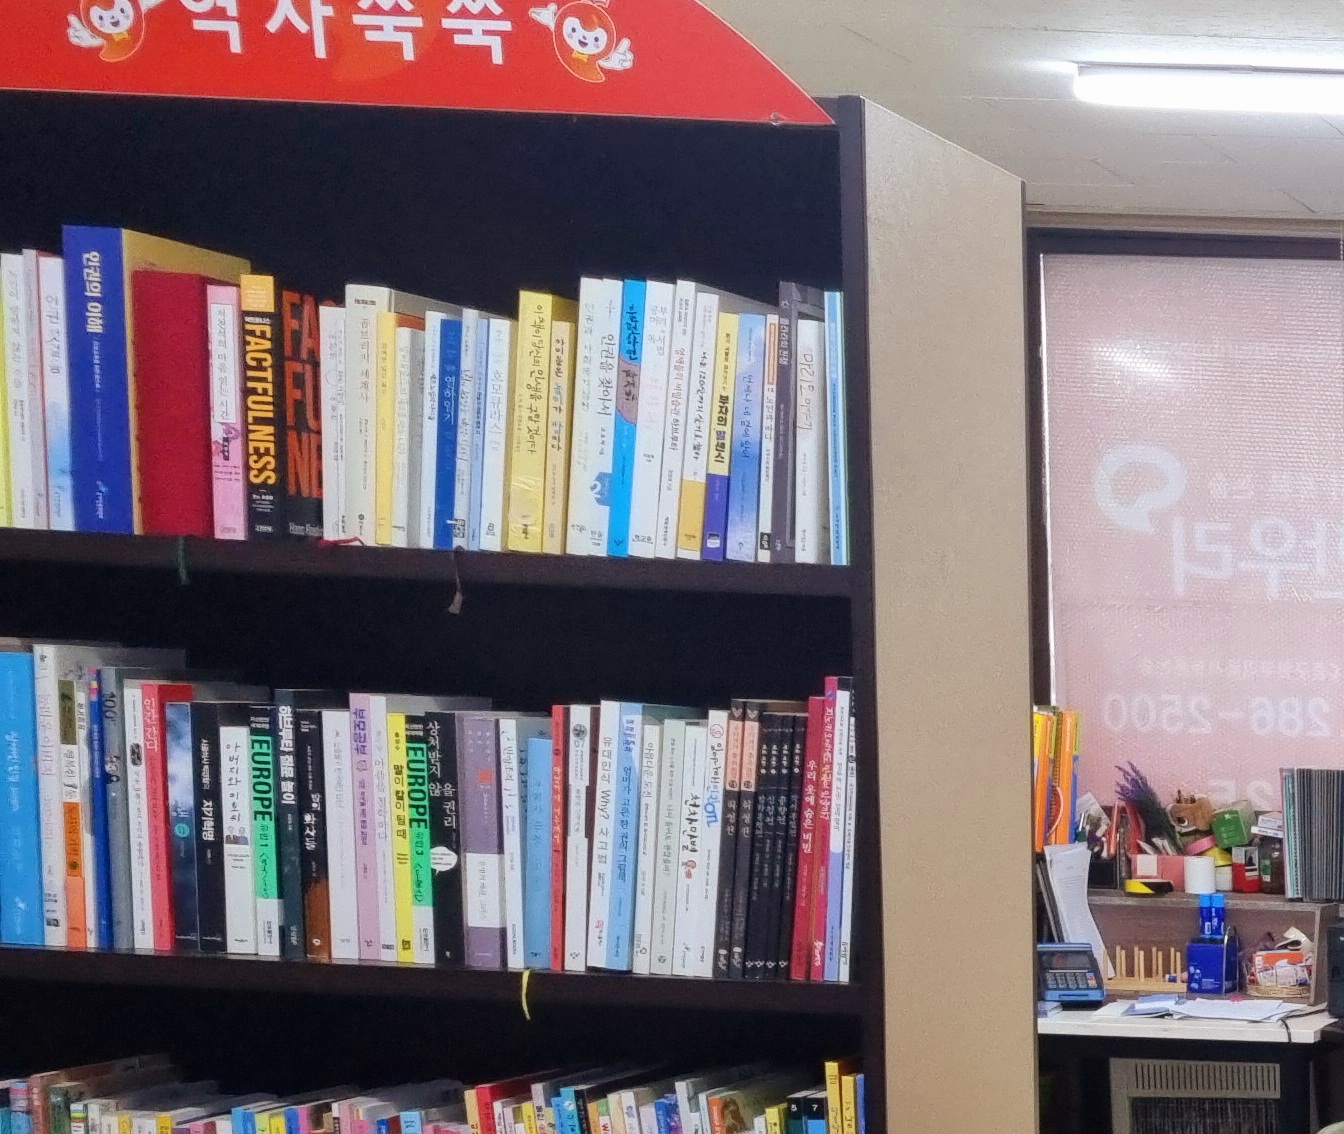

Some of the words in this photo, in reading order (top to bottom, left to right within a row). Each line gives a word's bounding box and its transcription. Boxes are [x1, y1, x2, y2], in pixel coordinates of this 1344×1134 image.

[83, 252, 102, 297] 인권의
[85, 303, 104, 333] 이해
[531, 317, 545, 337] 책이
[530, 339, 544, 366] 당신의
[600, 334, 615, 373] 인권을
[527, 369, 545, 401] 인생을
[799, 353, 814, 393] 마리오
[246, 324, 277, 485] FACTFULNESS
[598, 378, 613, 416] 찾아서
[716, 394, 731, 426] 부자의
[798, 398, 813, 431] 이야기
[278, 705, 294, 752] 하브루타
[353, 708, 368, 755] 부모공부
[251, 739, 273, 822] EUROPE
[281, 755, 294, 777] 질문
[428, 720, 441, 778] 상처받지
[443, 801, 456, 829] 권리
[806, 761, 816, 779] 우리
[282, 781, 295, 805] 놀이
[407, 746, 428, 829] EUROPE
[599, 790, 611, 820] Why?
[201, 800, 215, 841] 자기혁명
[682, 793, 699, 853] 천차만별
